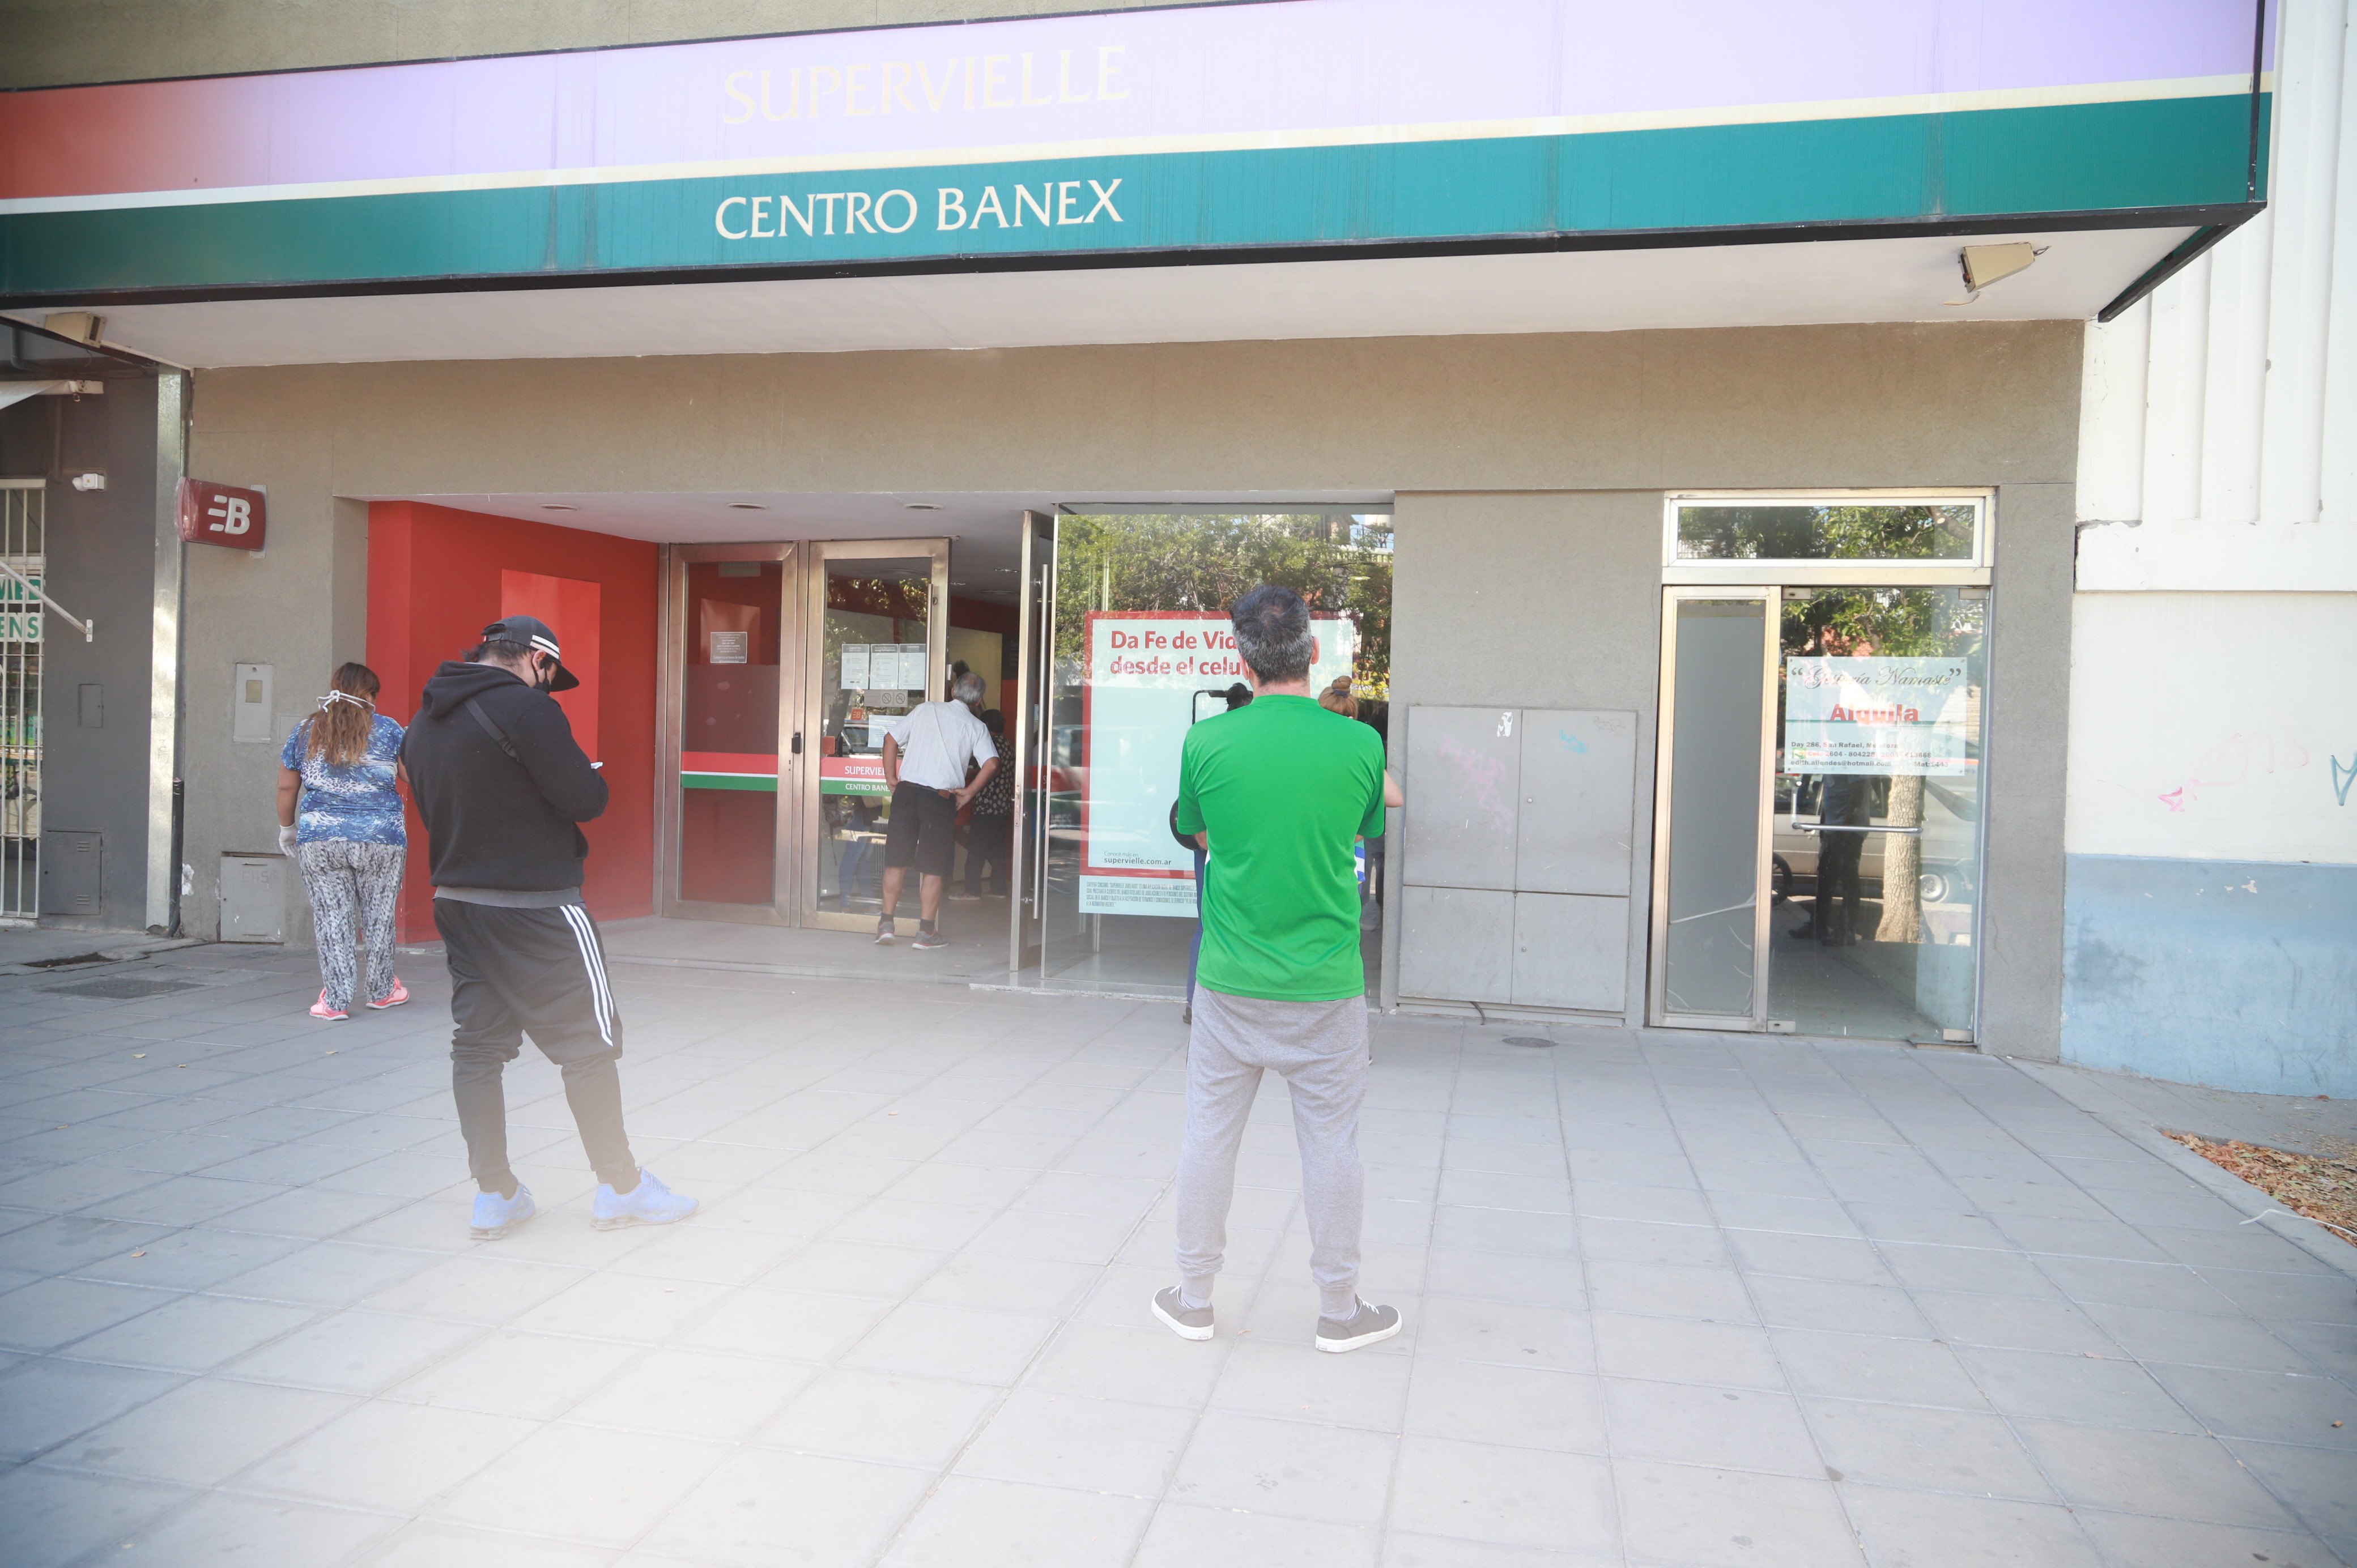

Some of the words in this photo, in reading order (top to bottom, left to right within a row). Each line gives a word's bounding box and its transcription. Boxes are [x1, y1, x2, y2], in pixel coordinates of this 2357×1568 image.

[722, 45, 1130, 123] SUPERVIELLE
[715, 189, 918, 239] CENTRO
[936, 178, 1124, 231] BANEX
[1111, 630, 1138, 649] Da
[1145, 630, 1167, 649] Fe
[1172, 630, 1197, 649] de
[1110, 655, 1171, 675] desde
[1176, 656, 1194, 675] el
[1830, 704, 1918, 725] Alquila
[1104, 857, 1172, 866] supervielle.com.ar
